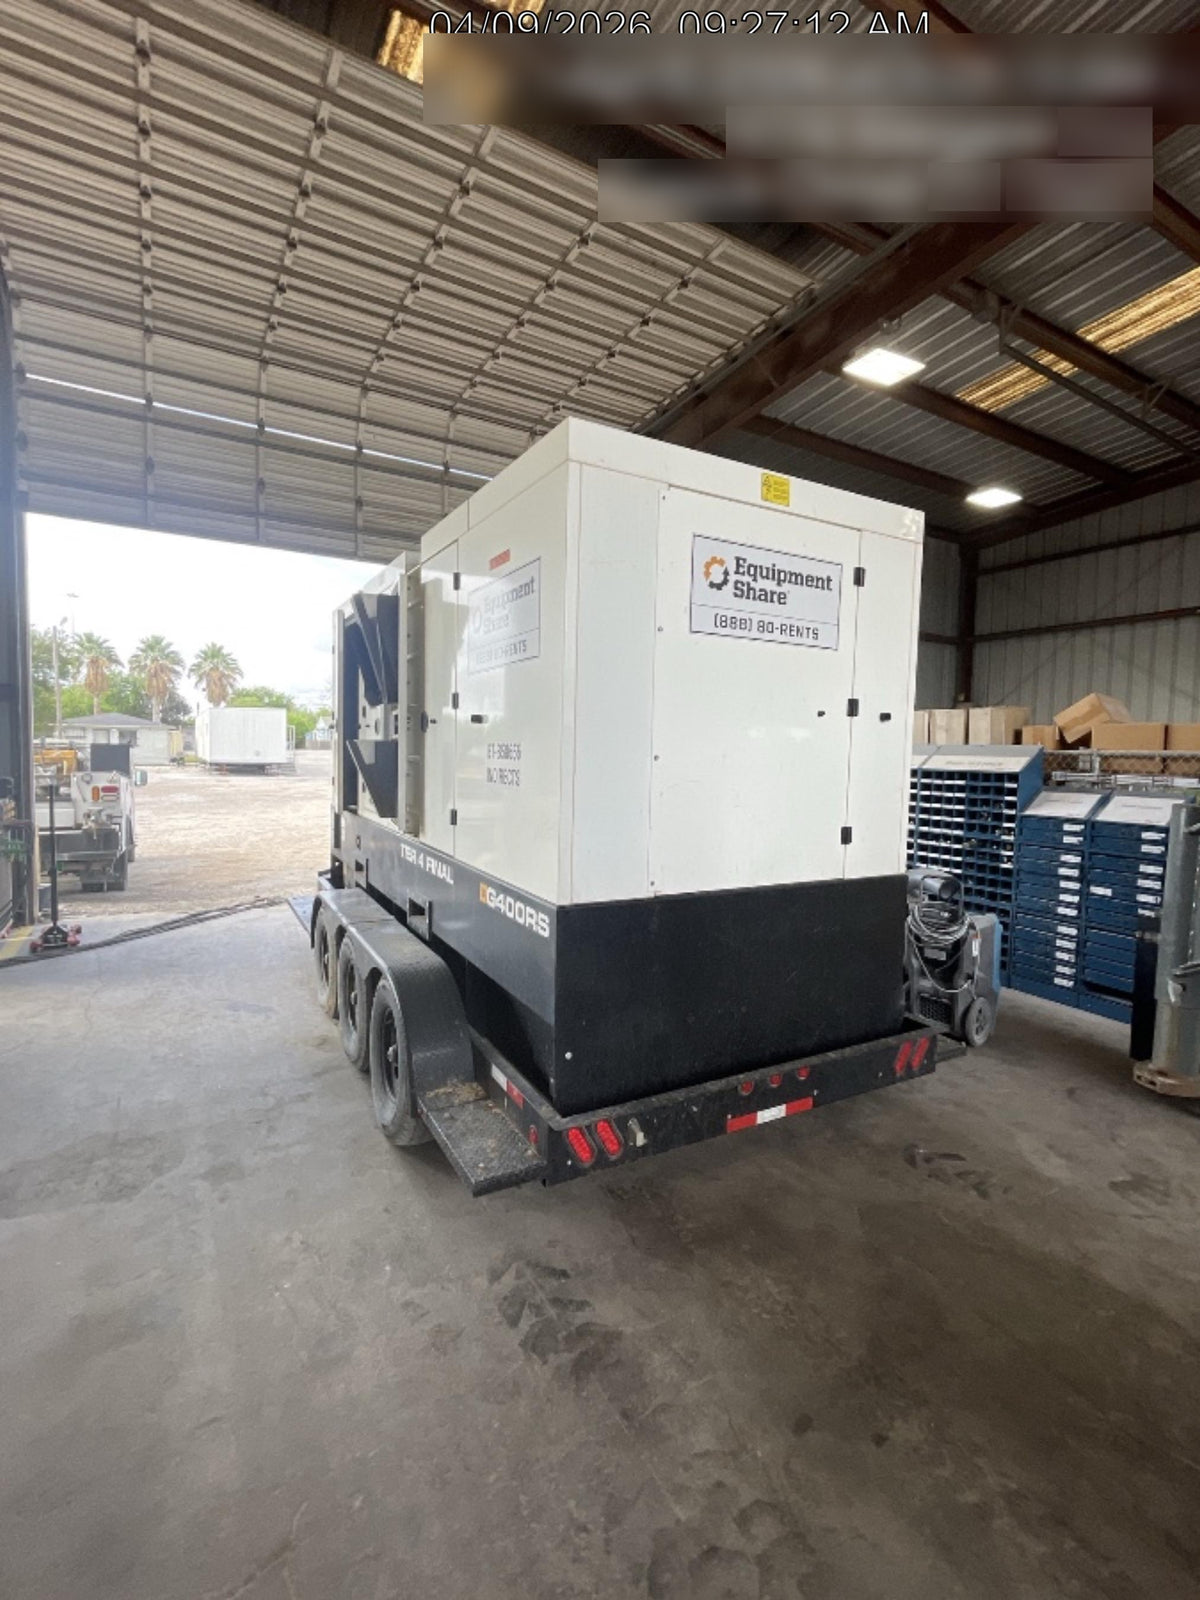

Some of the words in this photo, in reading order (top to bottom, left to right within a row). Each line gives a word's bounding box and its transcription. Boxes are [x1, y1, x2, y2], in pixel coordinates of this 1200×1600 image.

[733, 555, 833, 592] Equipment
[732, 579, 788, 605] Share
[714, 613, 753, 632] (888)
[757, 620, 819, 640] 80-RENTS
[418, 852, 424, 869] 4
[426, 855, 454, 885] FINAL
